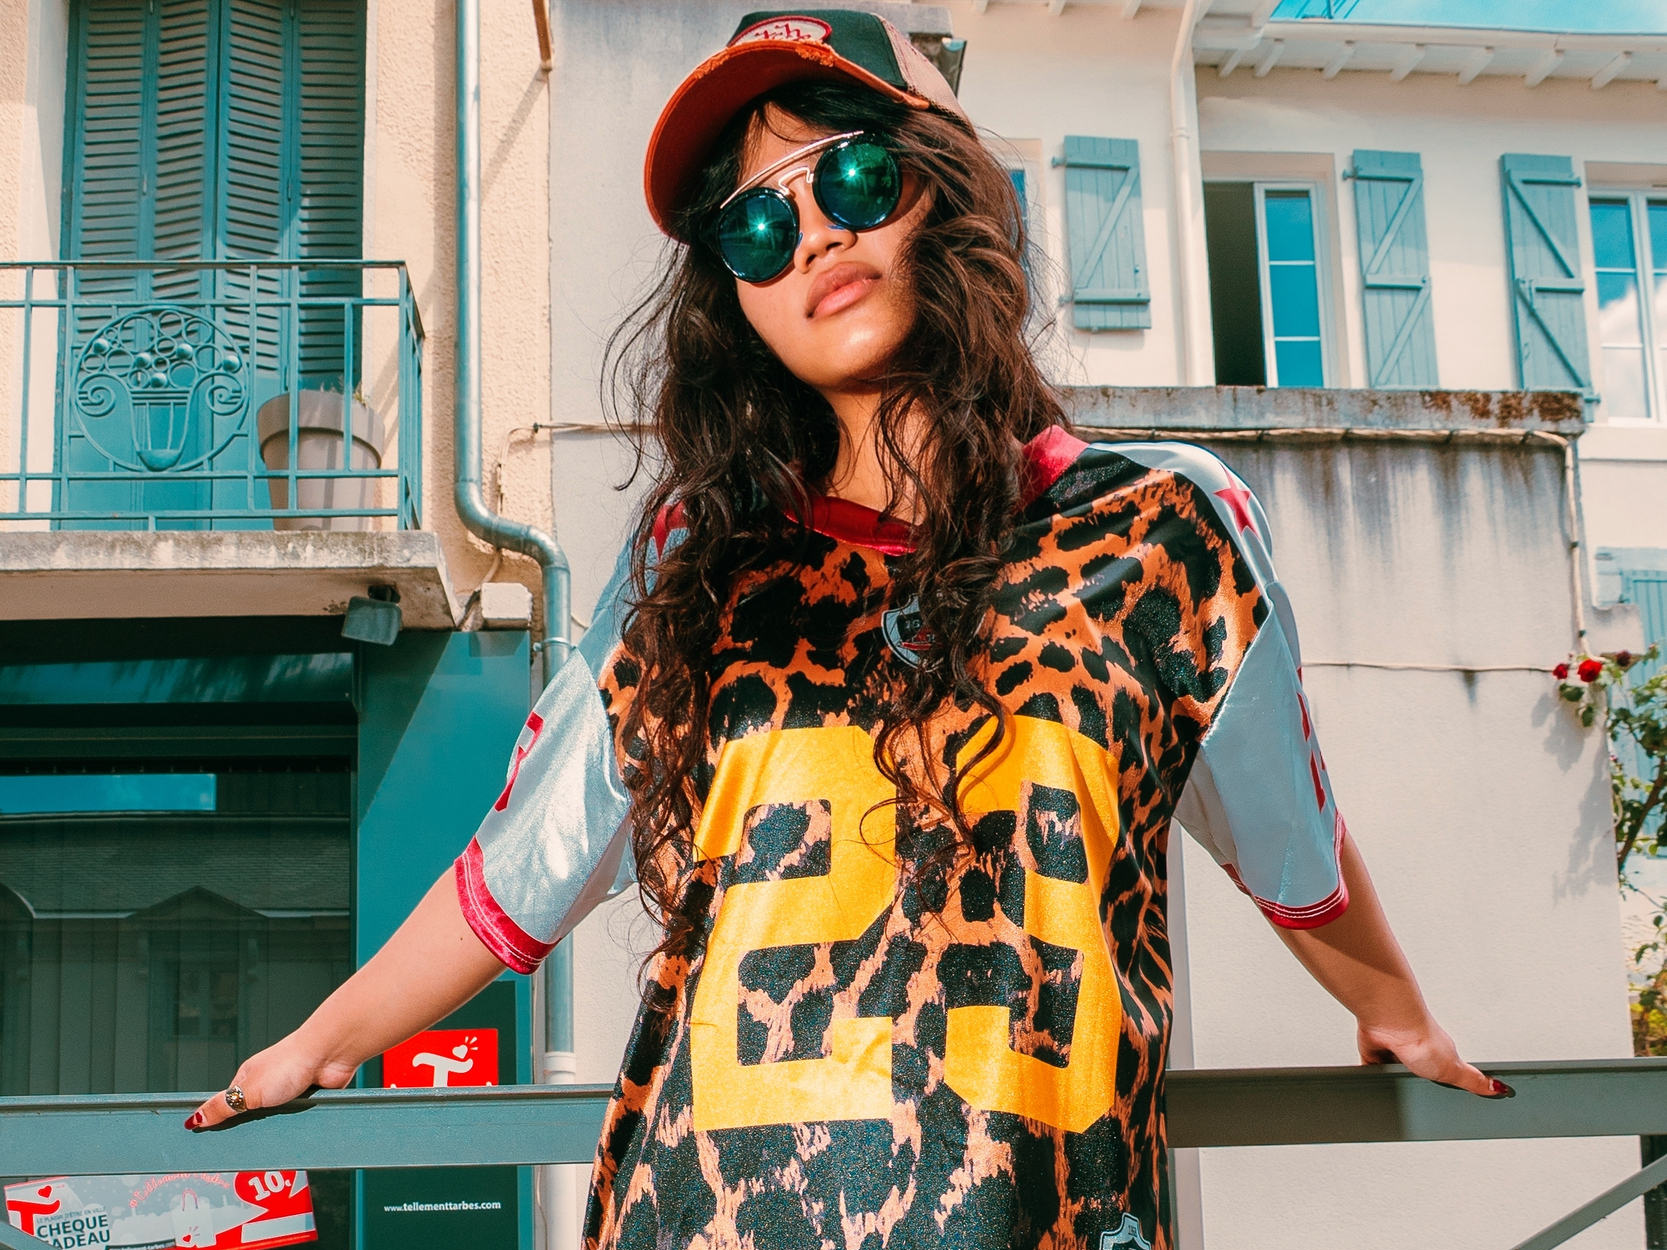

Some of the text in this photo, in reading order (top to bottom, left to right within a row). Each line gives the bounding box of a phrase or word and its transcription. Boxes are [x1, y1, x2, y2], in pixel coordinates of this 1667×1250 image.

[691, 714, 1121, 1134] 23
[383, 1200, 502, 1212] www.tellementtarbes.com
[45, 1229, 110, 1250] ADEAU
